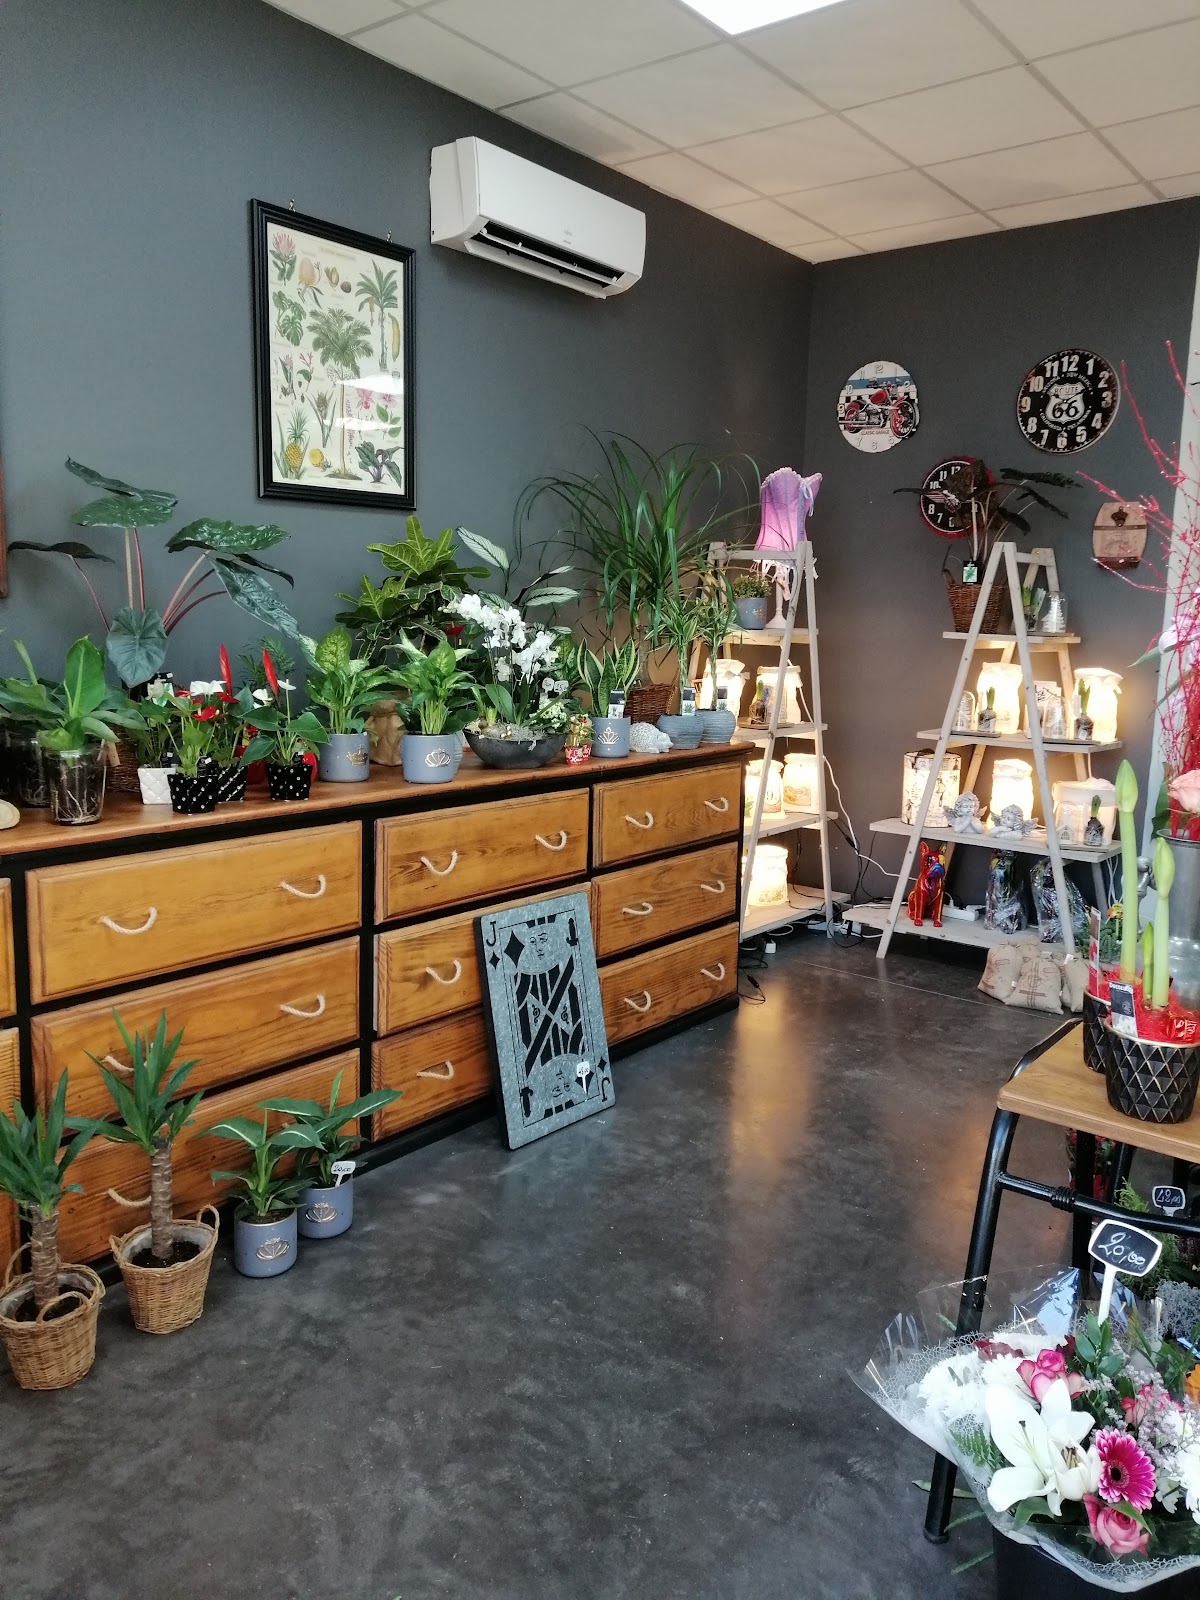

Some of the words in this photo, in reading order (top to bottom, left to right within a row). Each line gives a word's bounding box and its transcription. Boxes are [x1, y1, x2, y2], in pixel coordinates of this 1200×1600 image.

[875, 364, 884, 375] 12
[1044, 360, 1059, 378] 11
[1061, 355, 1080, 373] 12
[1086, 358, 1095, 375] 1
[1027, 375, 1045, 393] 10
[1097, 371, 1110, 388] 2
[845, 385, 853, 394] 10
[1054, 386, 1079, 395] ROUTE
[1020, 396, 1032, 413] 9
[1101, 391, 1113, 408] 3
[838, 404, 845, 414] 9
[1052, 399, 1080, 419] 66
[1027, 416, 1038, 434] 8
[1091, 412, 1103, 430] 4
[1040, 429, 1049, 446] 7
[1056, 431, 1068, 449] 6
[1075, 426, 1087, 443] 5
[939, 471, 947, 481] 11
[928, 504, 935, 514] 8
[937, 513, 943, 523] 7
[485, 921, 497, 948] J
[601, 1077, 611, 1103] J
[1097, 1231, 1146, 1265] 20,00
